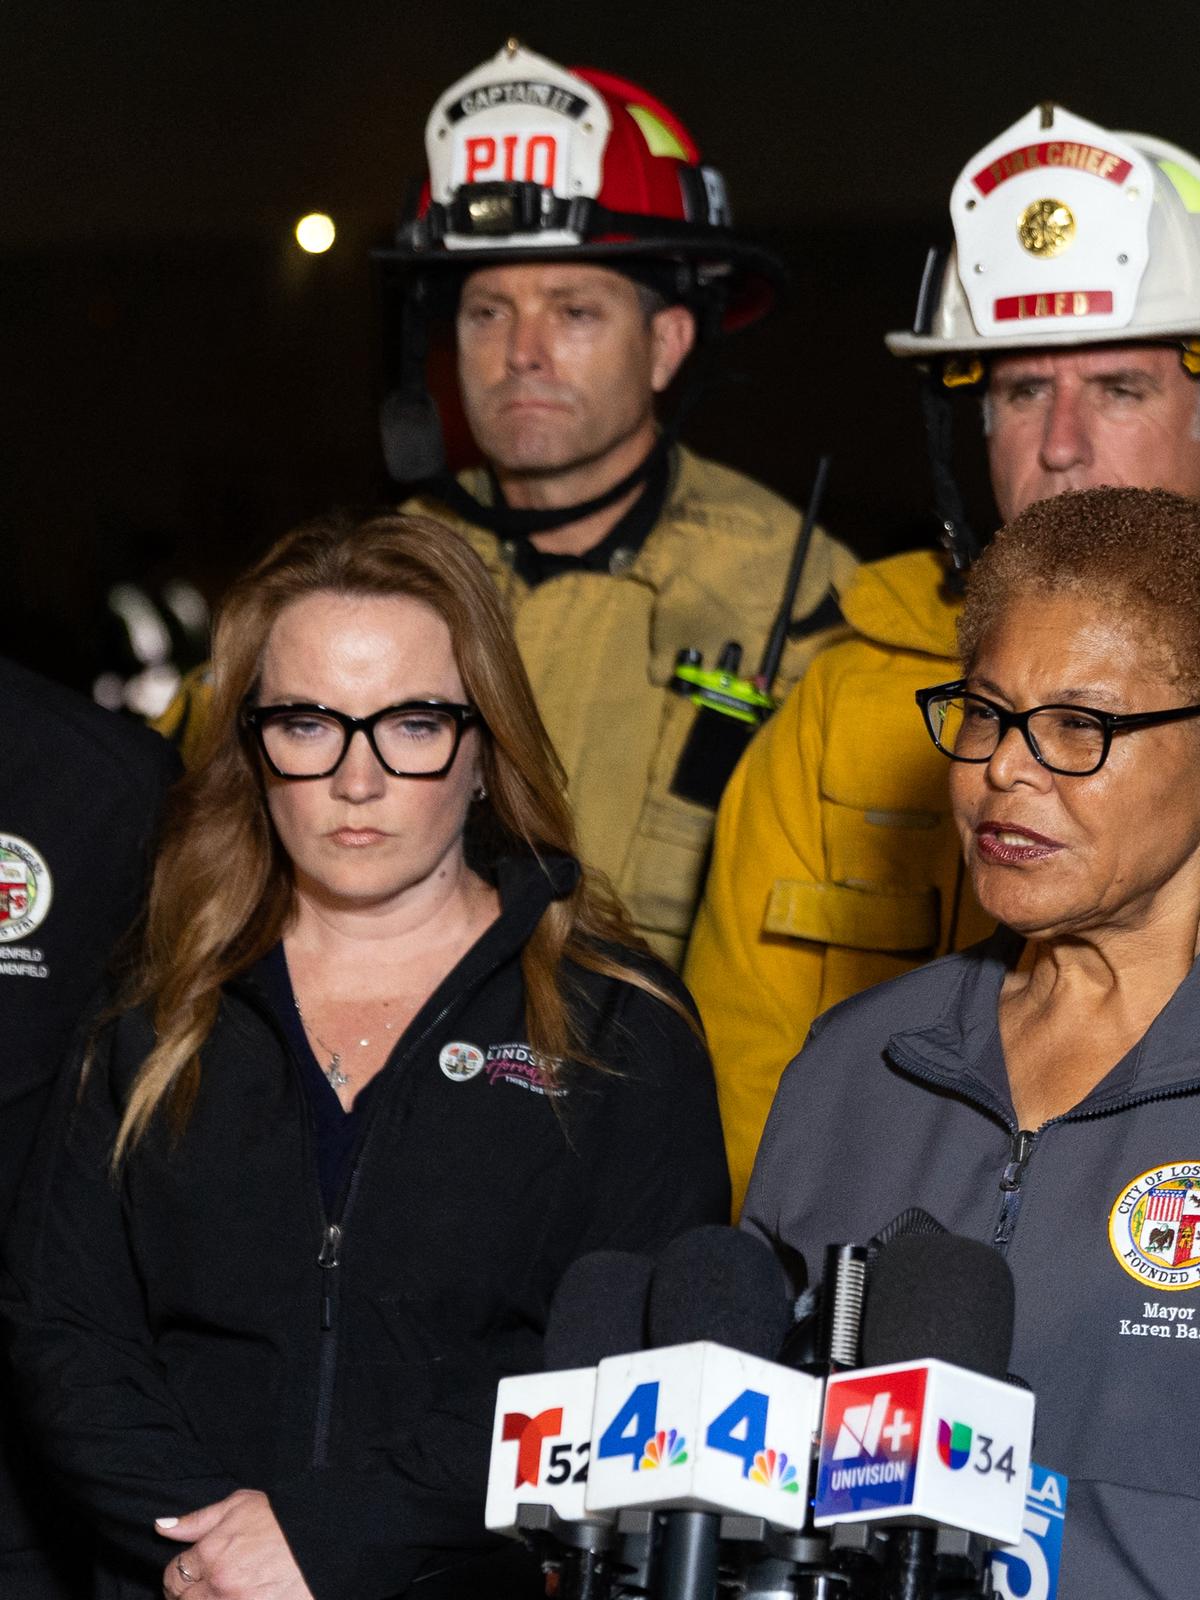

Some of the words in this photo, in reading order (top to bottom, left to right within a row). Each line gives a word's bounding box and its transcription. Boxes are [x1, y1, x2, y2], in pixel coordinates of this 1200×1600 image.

[461, 82, 551, 116] CAPTAIN
[1047, 142, 1121, 178] CHIEF
[1118, 1185, 1143, 1215] CITY
[1145, 1170, 1164, 1186] OF
[1123, 1249, 1190, 1284] FOUNDED
[1119, 1320, 1171, 1338] Karen
[1142, 1302, 1196, 1321] Mayor
[597, 1380, 661, 1473] 4
[705, 1388, 770, 1480] 4
[831, 1460, 907, 1492] UNIVISION
[973, 1433, 1017, 1484] 34
